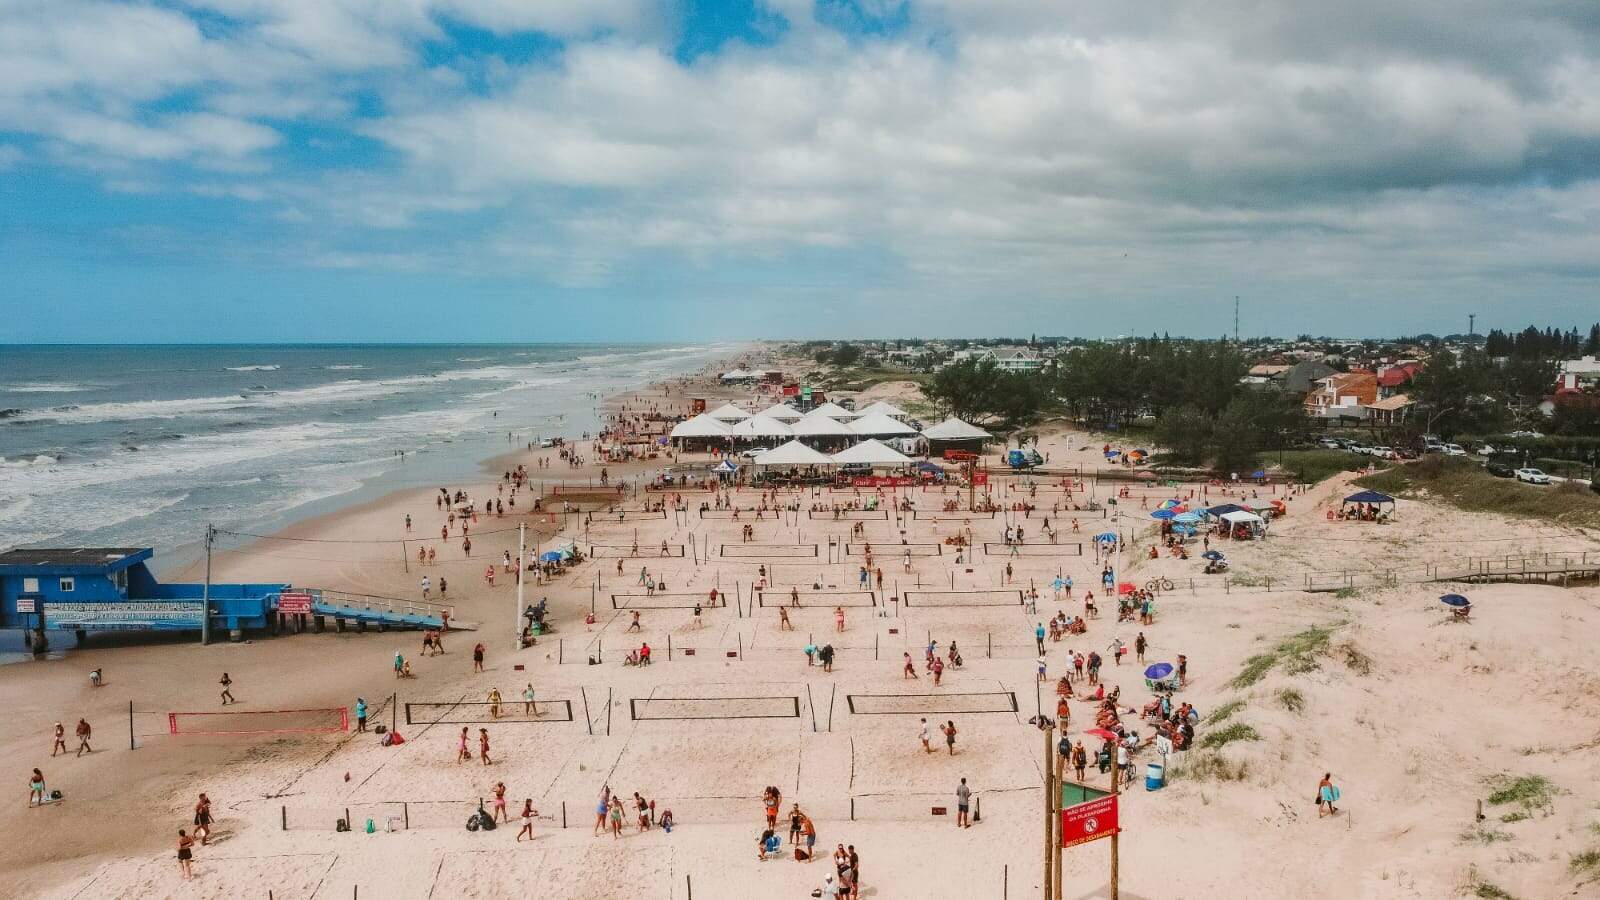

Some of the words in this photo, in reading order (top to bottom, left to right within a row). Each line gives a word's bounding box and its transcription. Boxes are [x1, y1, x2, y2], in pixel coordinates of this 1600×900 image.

[1066, 808, 1079, 816] NÃO
[1087, 798, 1113, 811] APROXIME
[1077, 806, 1112, 819] PLATAFORMA
